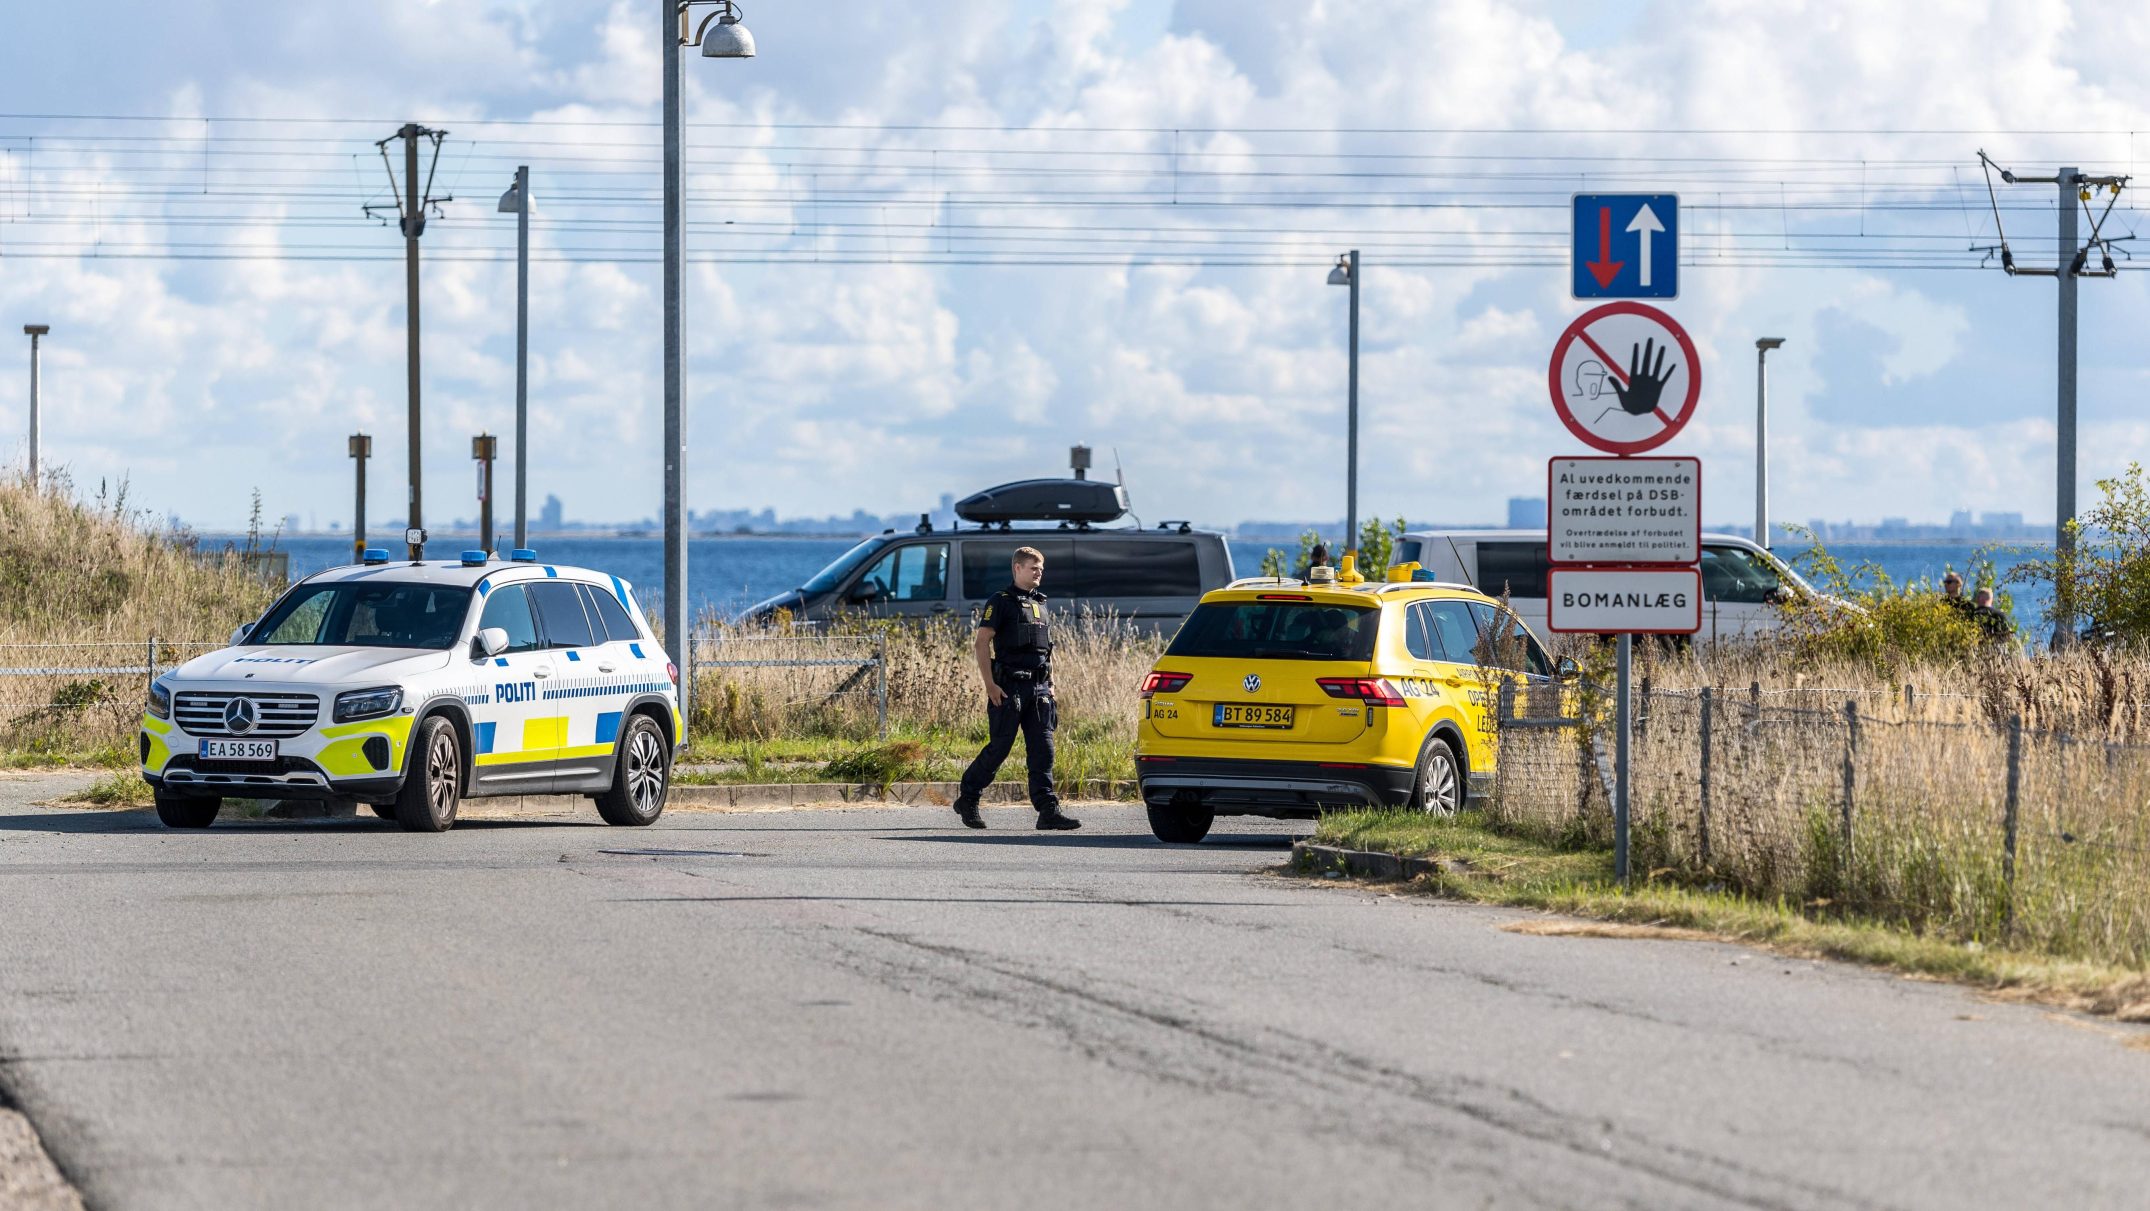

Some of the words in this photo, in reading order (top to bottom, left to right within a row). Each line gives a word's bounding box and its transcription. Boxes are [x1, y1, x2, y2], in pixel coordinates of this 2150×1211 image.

[1560, 474, 1574, 484] Al
[1580, 474, 1690, 484] uvedkommende
[1566, 490, 1622, 500] færdsel
[1627, 490, 1643, 502] på
[1649, 490, 1685, 500] DSB-
[1562, 506, 1622, 517] området
[1628, 506, 1688, 517] forbudt.
[1566, 529, 1628, 537] Overtrædelse
[1631, 529, 1640, 537] af
[1643, 529, 1684, 537] forbudet
[1560, 541, 1572, 549] vil
[1574, 541, 1596, 549] blive
[1600, 541, 1636, 549] anmeldt
[1639, 541, 1650, 549] til
[1652, 541, 1690, 550] politiet.
[1563, 593, 1686, 607] BOMANLÆG
[495, 681, 535, 703] POLITI
[1401, 678, 1421, 697] AG
[1421, 679, 1440, 697] 24
[1153, 709, 1165, 719] AG
[1167, 710, 1178, 719] 24
[1224, 707, 1242, 721] BT
[1245, 707, 1262, 722] 89
[1265, 709, 1291, 722] 584
[209, 742, 226, 756] EA
[229, 743, 245, 757] 58
[248, 743, 273, 758] 569
